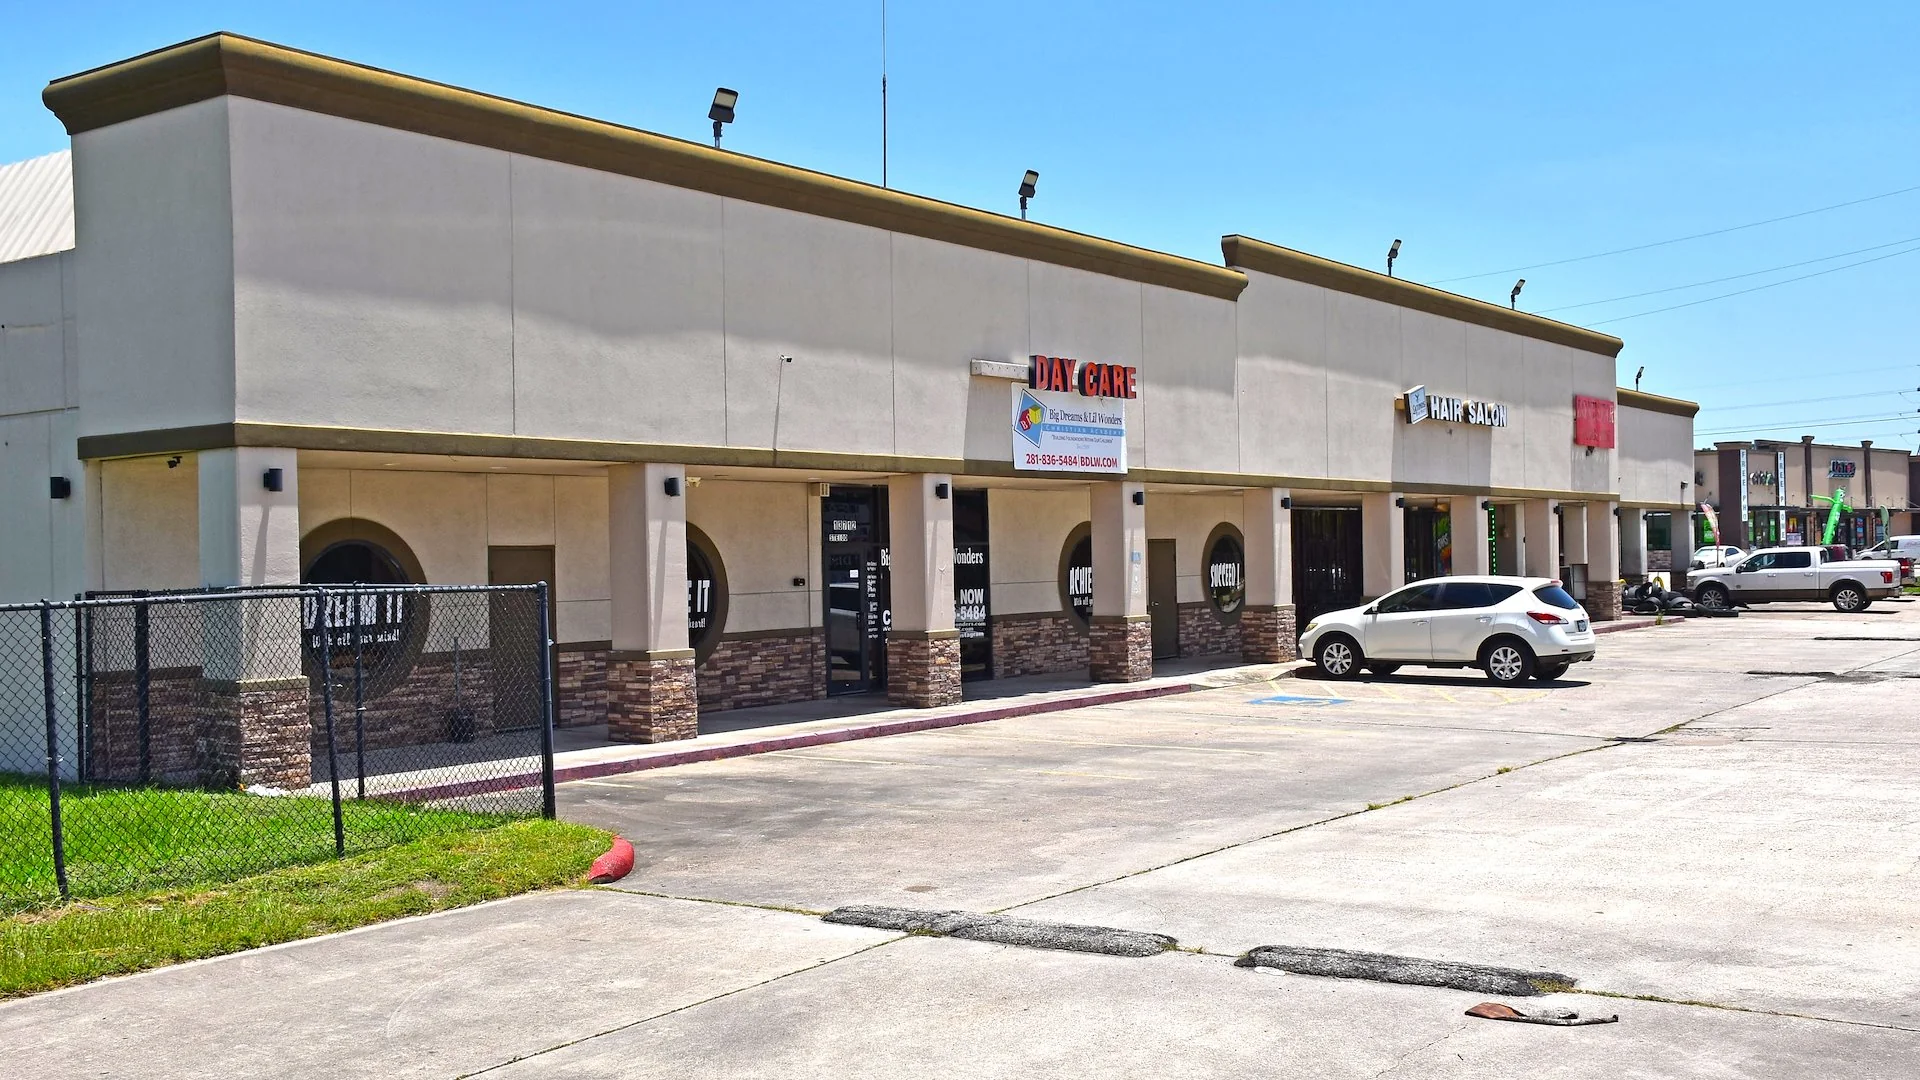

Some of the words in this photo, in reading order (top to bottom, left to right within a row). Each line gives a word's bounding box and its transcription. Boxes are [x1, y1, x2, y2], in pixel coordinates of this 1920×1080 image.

[1031, 355, 1076, 392] DAY
[1082, 362, 1136, 399] CARE
[1049, 409, 1059, 423] Big
[1060, 410, 1083, 422] Dreams
[1084, 412, 1089, 423] &
[1098, 413, 1122, 425] Wonders
[1430, 395, 1462, 422] HAIR
[1467, 400, 1507, 427] SALON
[1044, 425, 1086, 433] CHRISTIAN
[1026, 453, 1077, 466] 281-836-5484
[1080, 456, 1118, 468] BDLW.COM
[697, 580, 710, 613] IT
[960, 588, 984, 605] NOW
